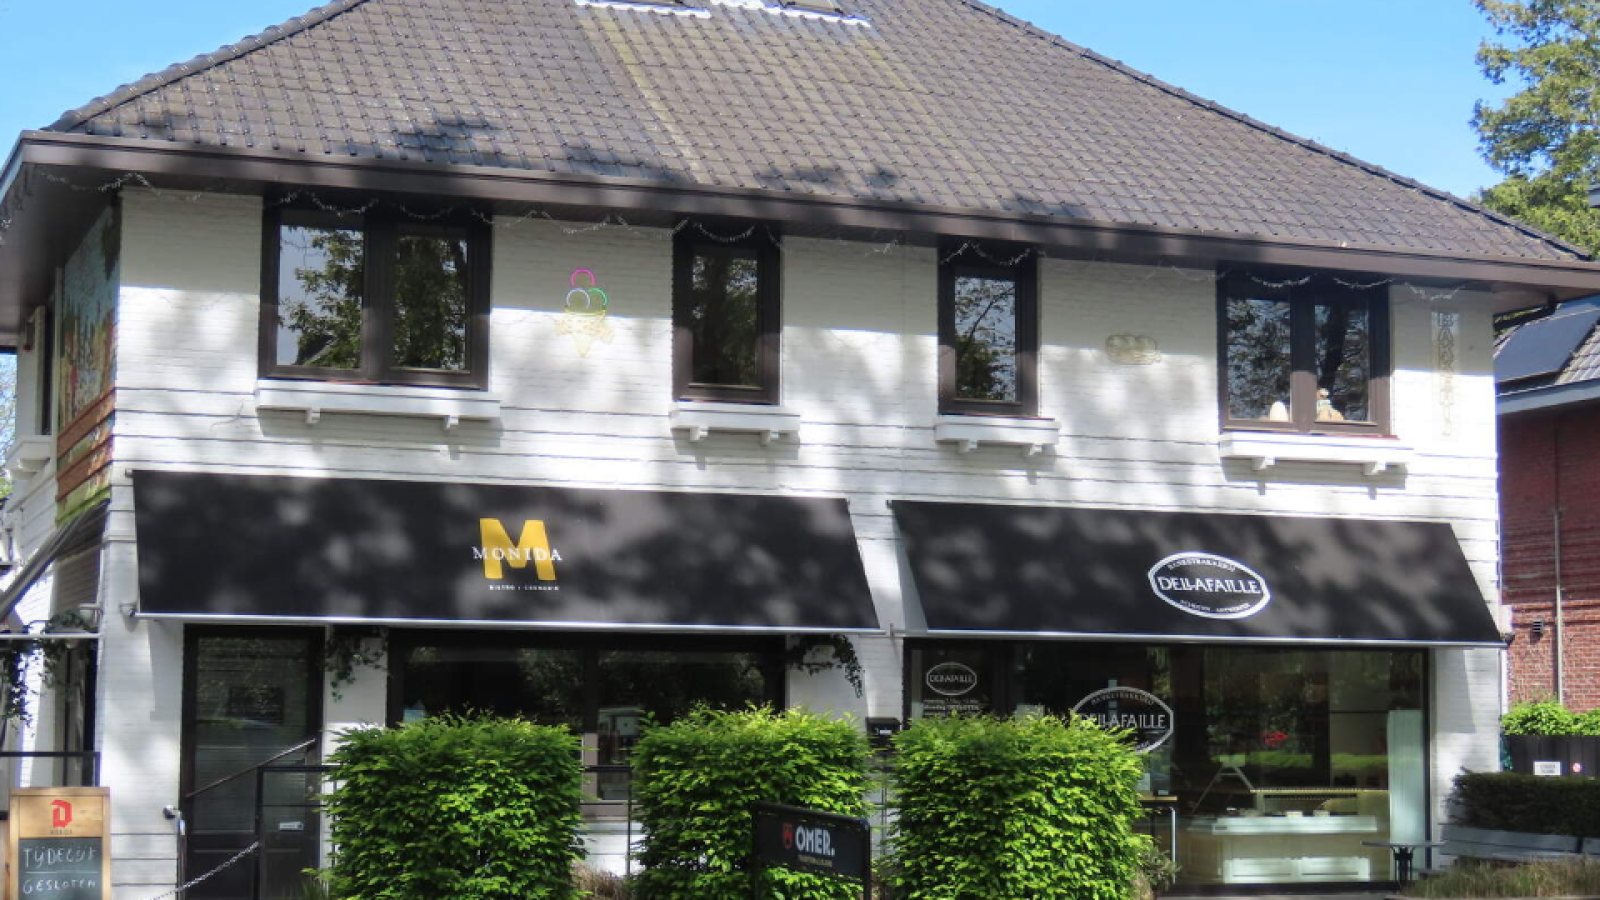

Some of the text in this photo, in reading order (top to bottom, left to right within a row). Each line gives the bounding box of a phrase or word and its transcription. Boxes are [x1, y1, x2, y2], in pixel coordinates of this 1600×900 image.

[471, 546, 563, 561] MONIDA
[1157, 576, 1261, 593] DELLAFAILLE
[795, 825, 835, 856] OMER.
[23, 879, 96, 894] GESLOTEN
